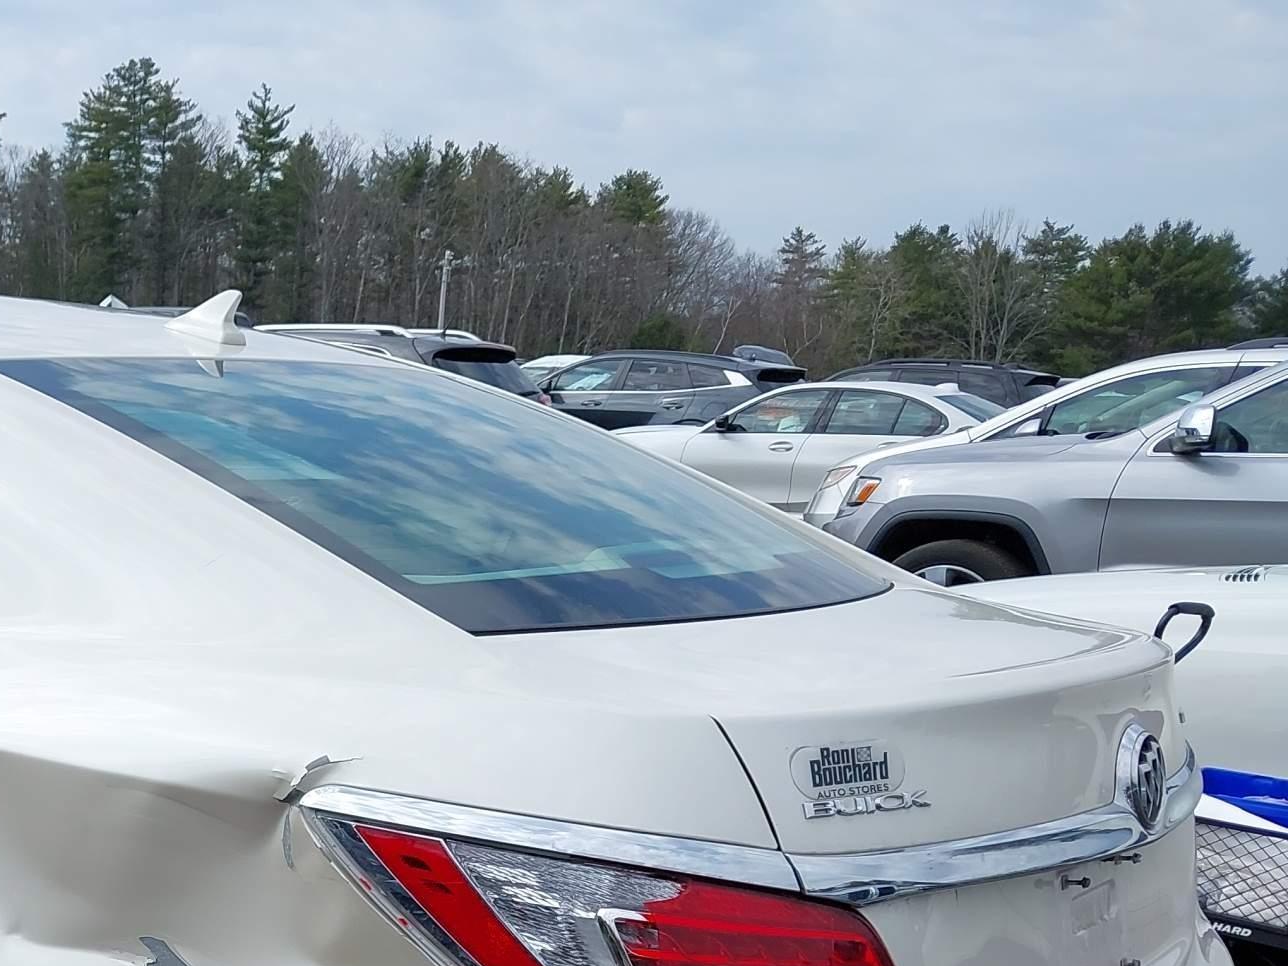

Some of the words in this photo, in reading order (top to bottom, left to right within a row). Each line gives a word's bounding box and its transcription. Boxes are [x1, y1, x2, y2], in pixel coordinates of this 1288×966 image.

[809, 748, 889, 787] Bouchard
[820, 747, 850, 766] Ron
[817, 787, 847, 800] AUTO
[849, 783, 890, 796] STORES
[802, 790, 931, 819] BUICK
